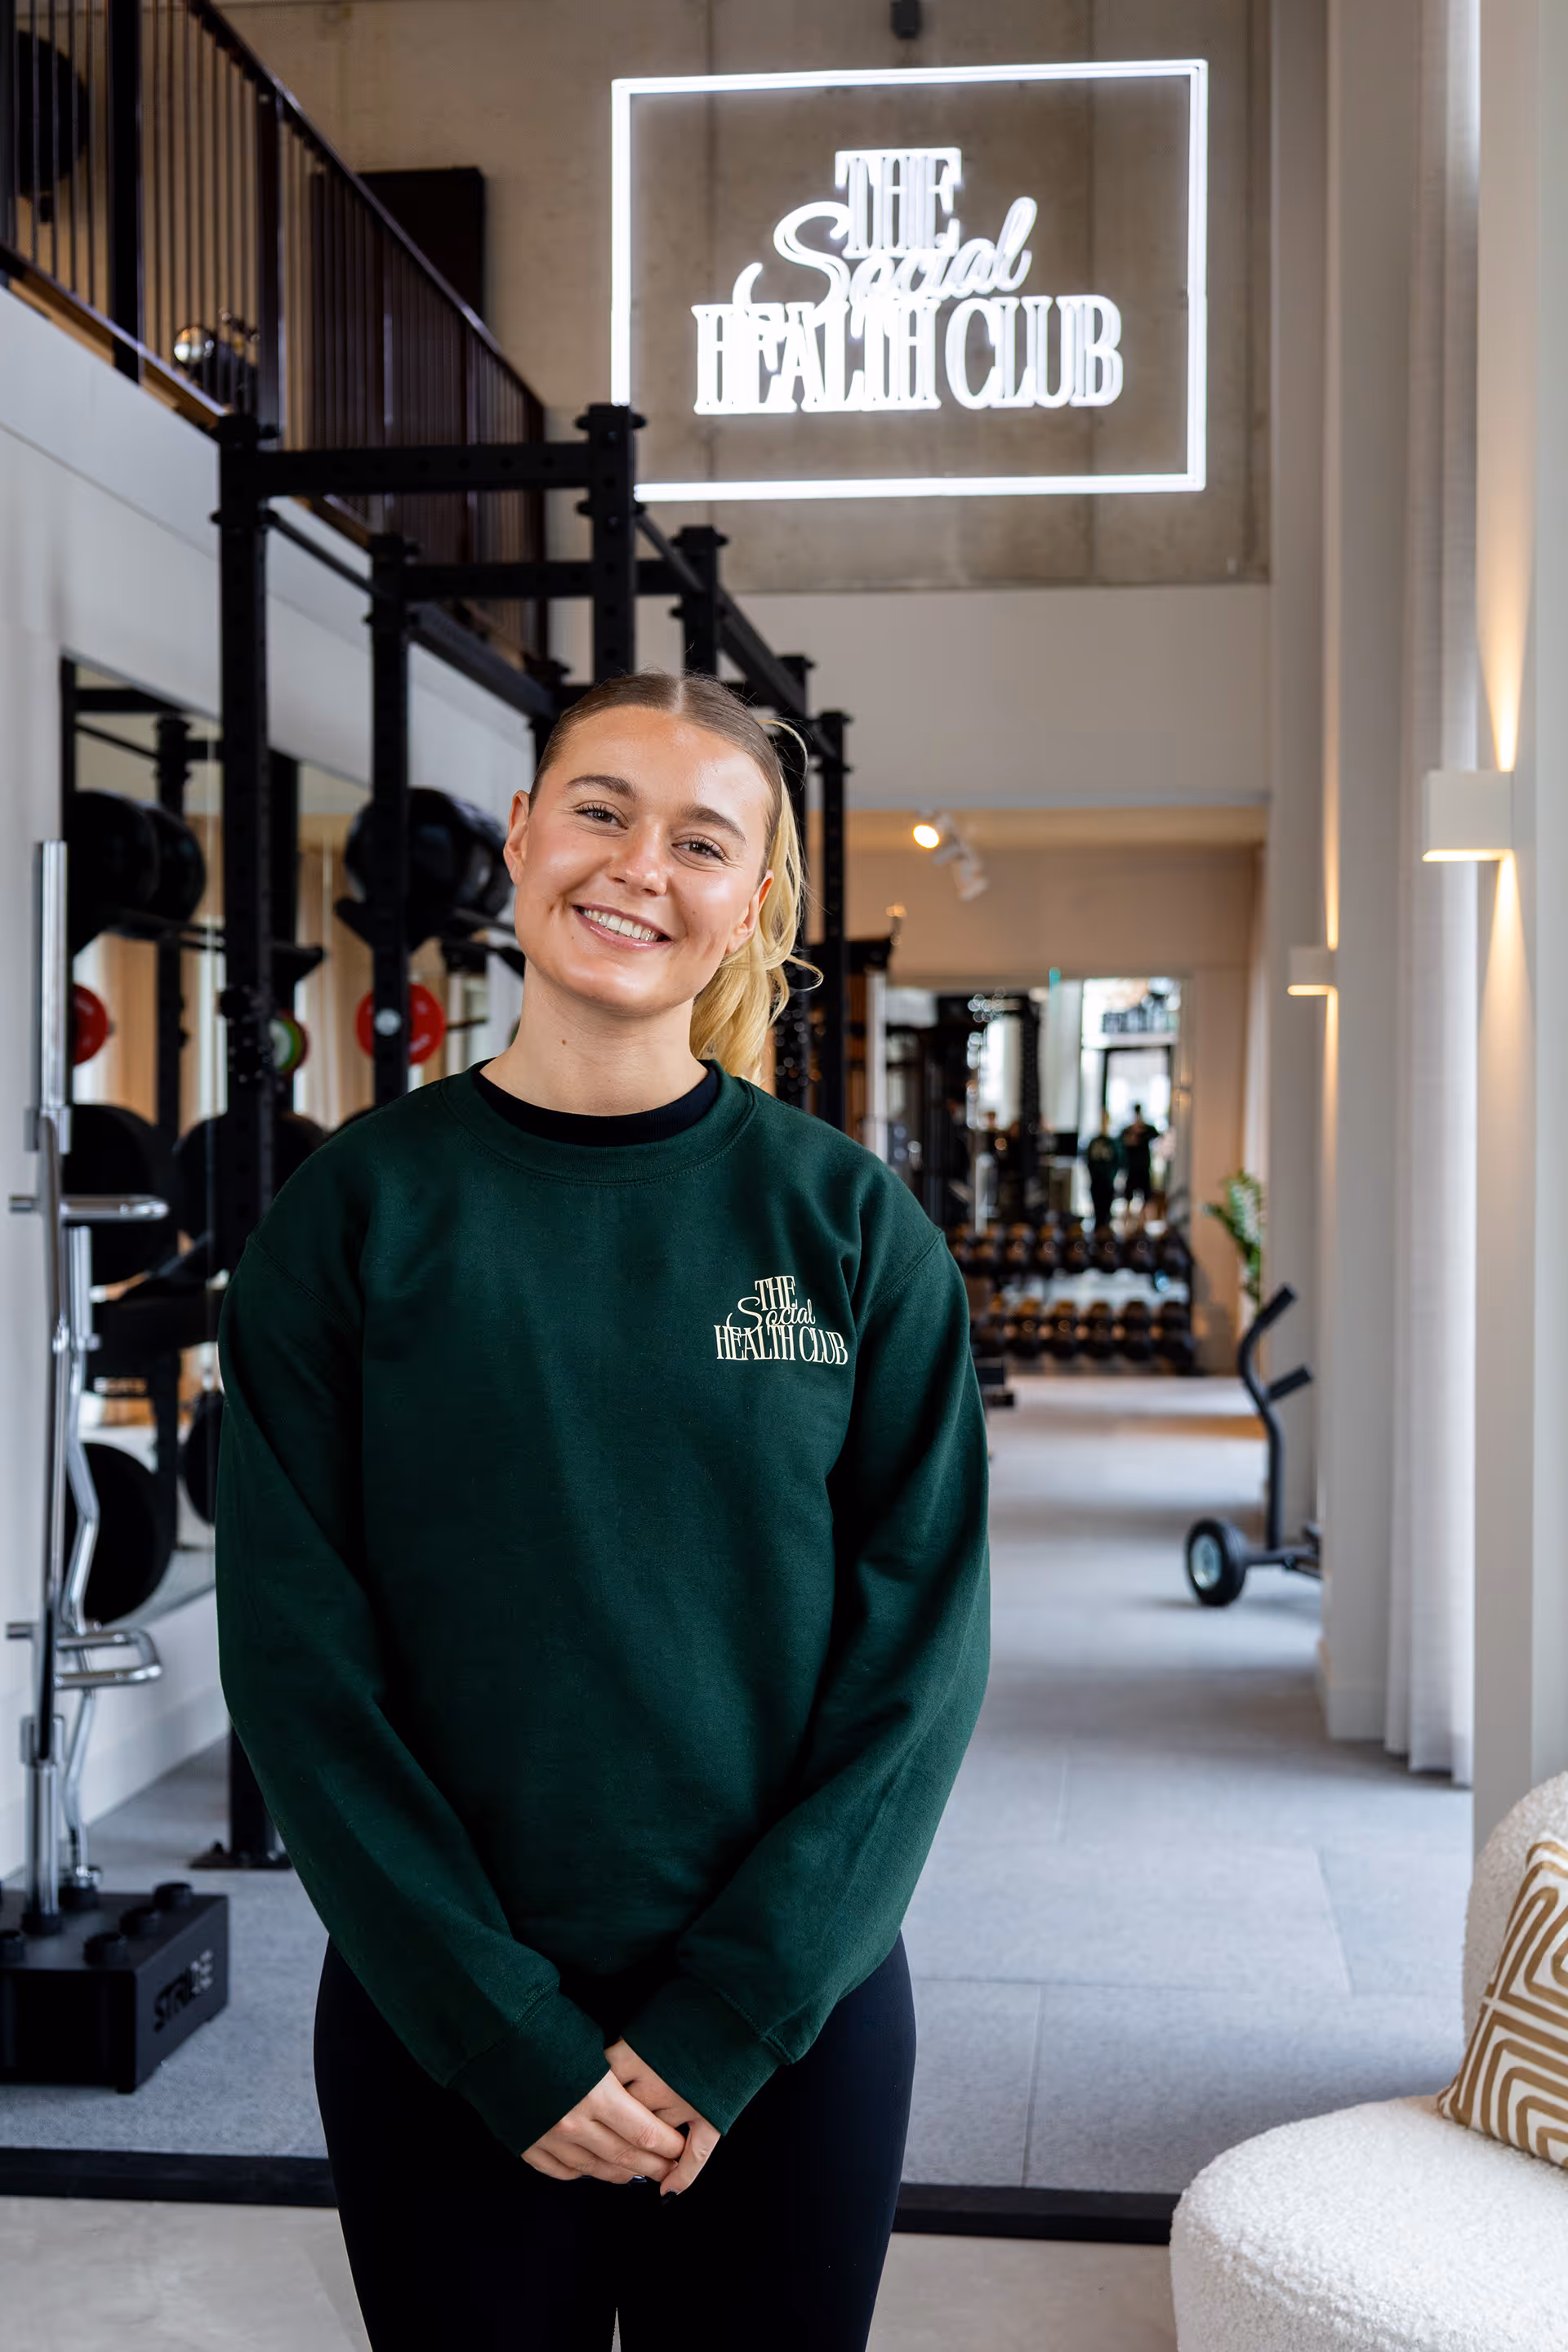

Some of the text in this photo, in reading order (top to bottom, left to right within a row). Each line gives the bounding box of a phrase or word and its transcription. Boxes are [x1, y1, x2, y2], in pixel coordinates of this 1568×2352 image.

[834, 146, 963, 259] THE
[733, 196, 1038, 332] Social
[691, 295, 1124, 415] HEALTH CLUB
[726, 1296, 816, 1336] Social
[754, 1276, 797, 1312] THE
[713, 1324, 849, 1365] HEALTH CLUB
